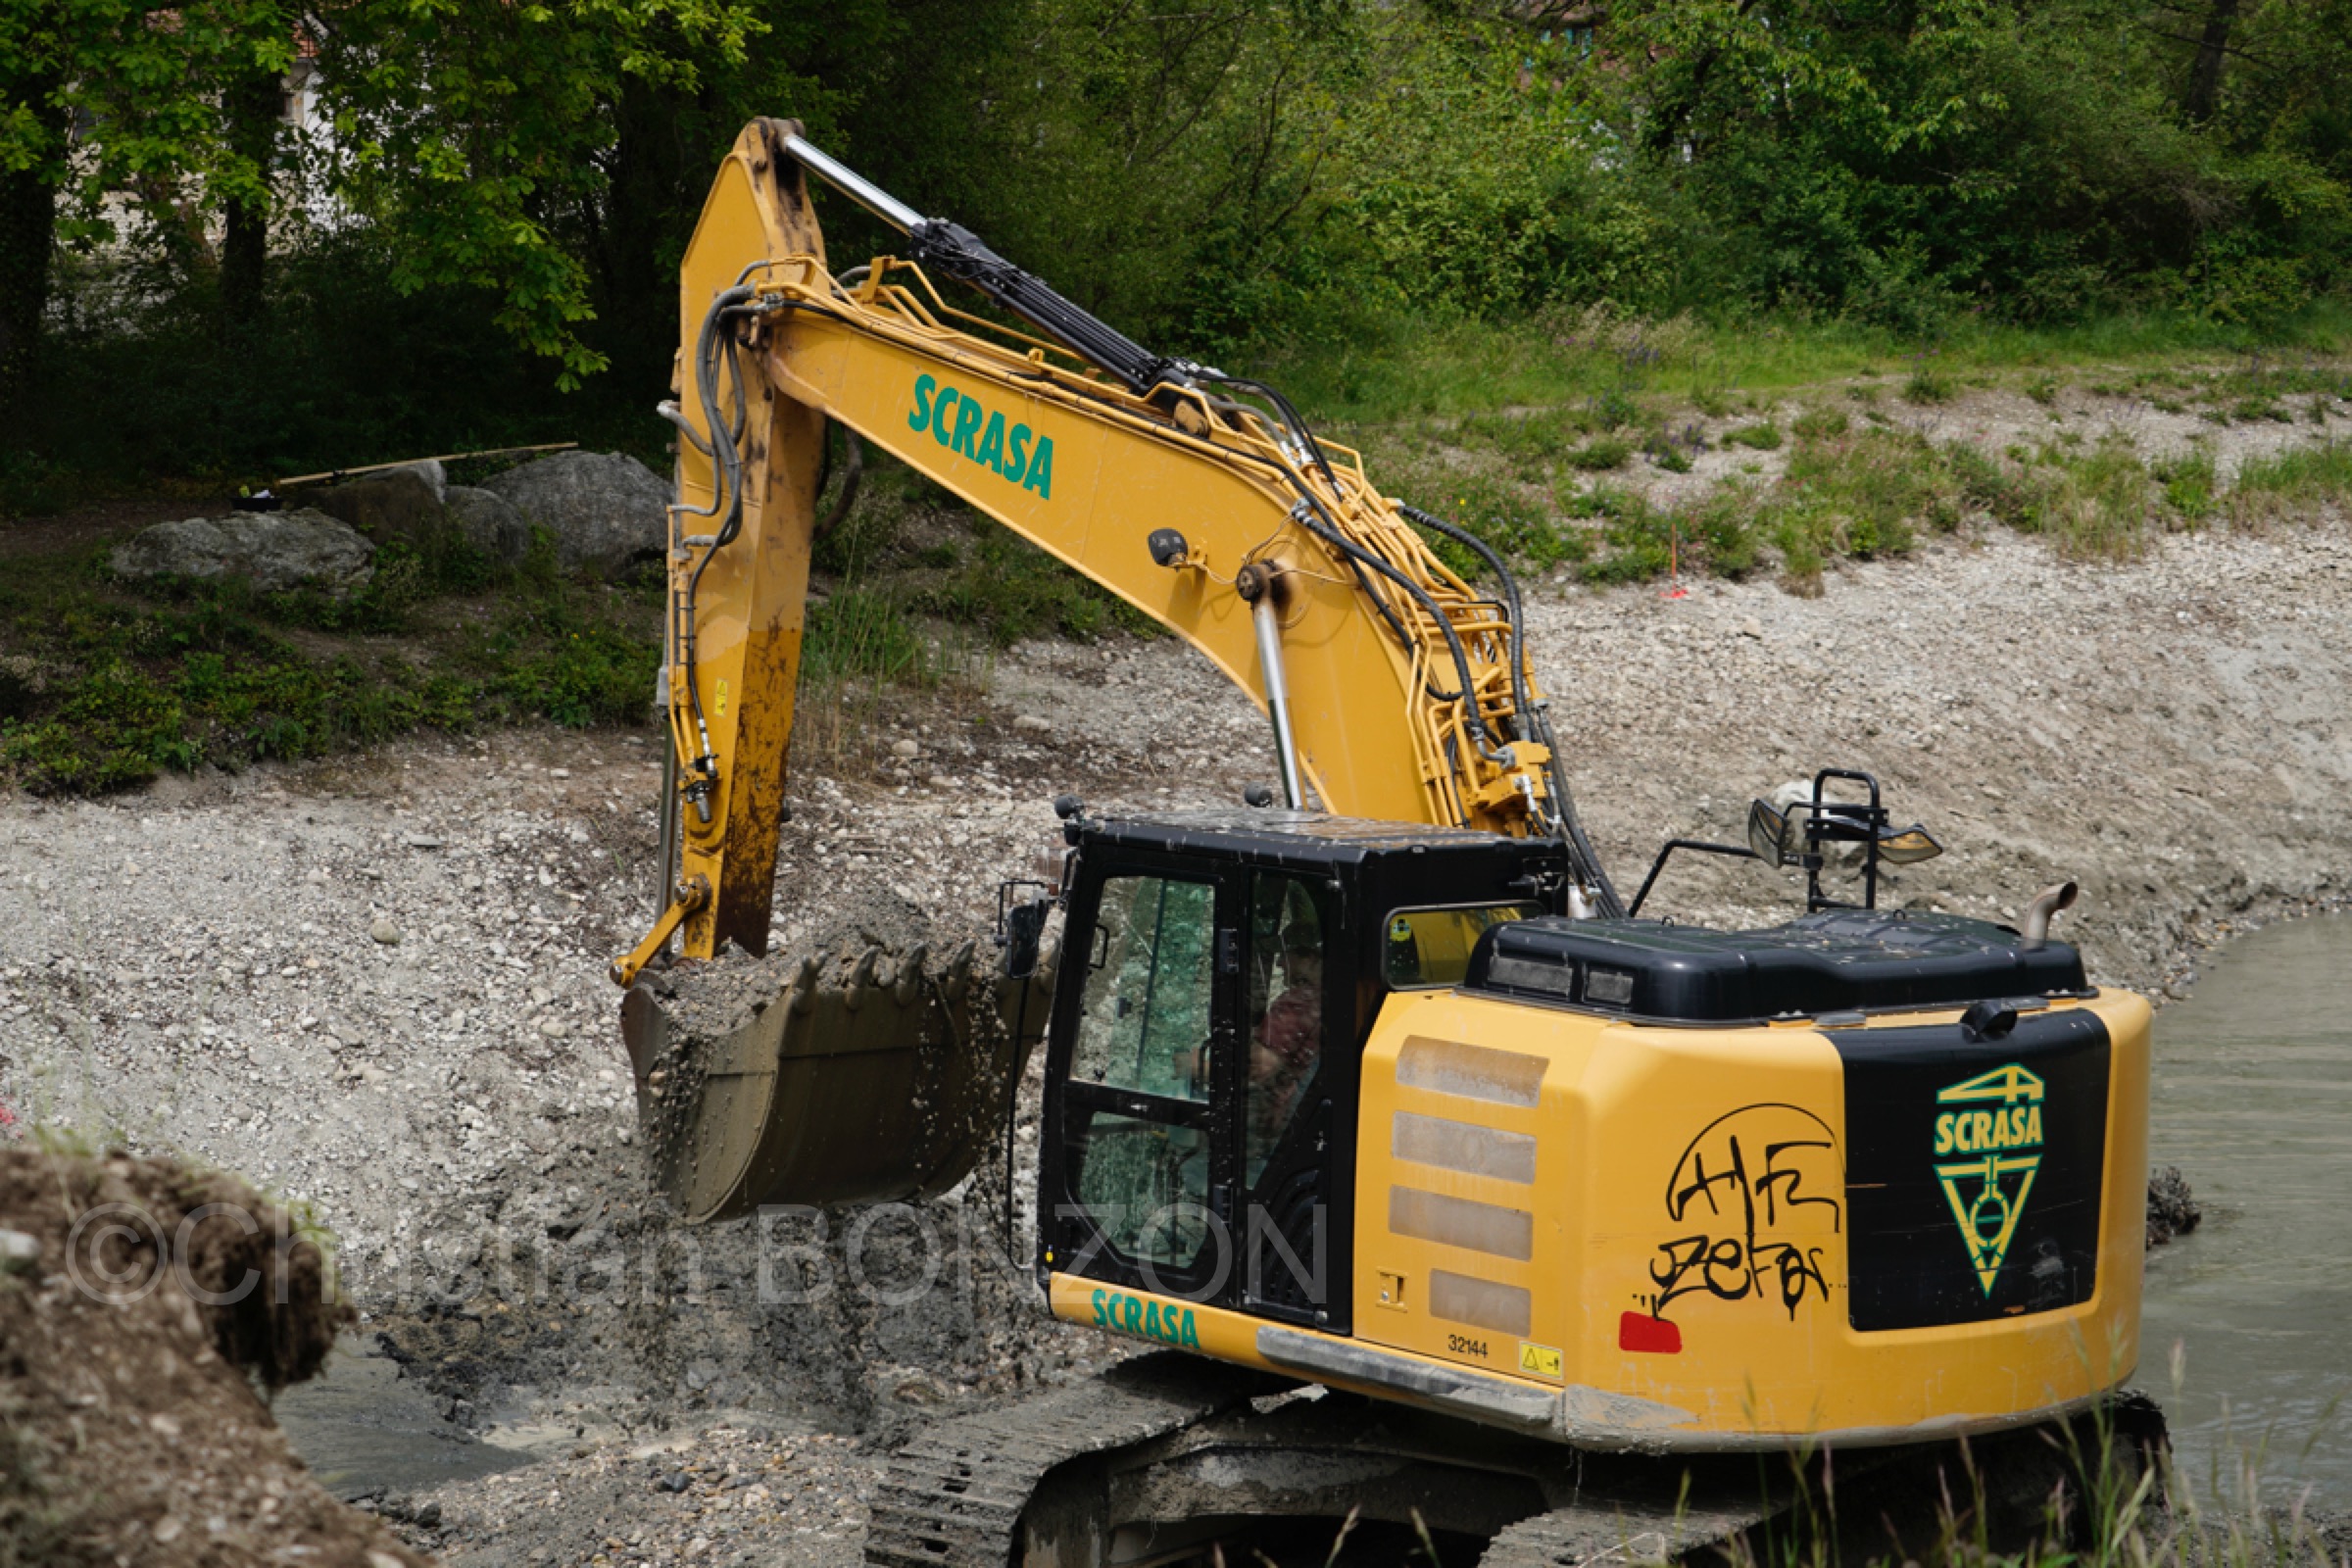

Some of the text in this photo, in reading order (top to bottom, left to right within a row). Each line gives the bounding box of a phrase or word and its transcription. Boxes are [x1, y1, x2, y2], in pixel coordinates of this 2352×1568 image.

[907, 373, 1054, 501] SCRASA
[1934, 1103, 2044, 1156] SCRASA
[1092, 1289, 1200, 1349] SCRASA
[1447, 1334, 1489, 1358] 32144
